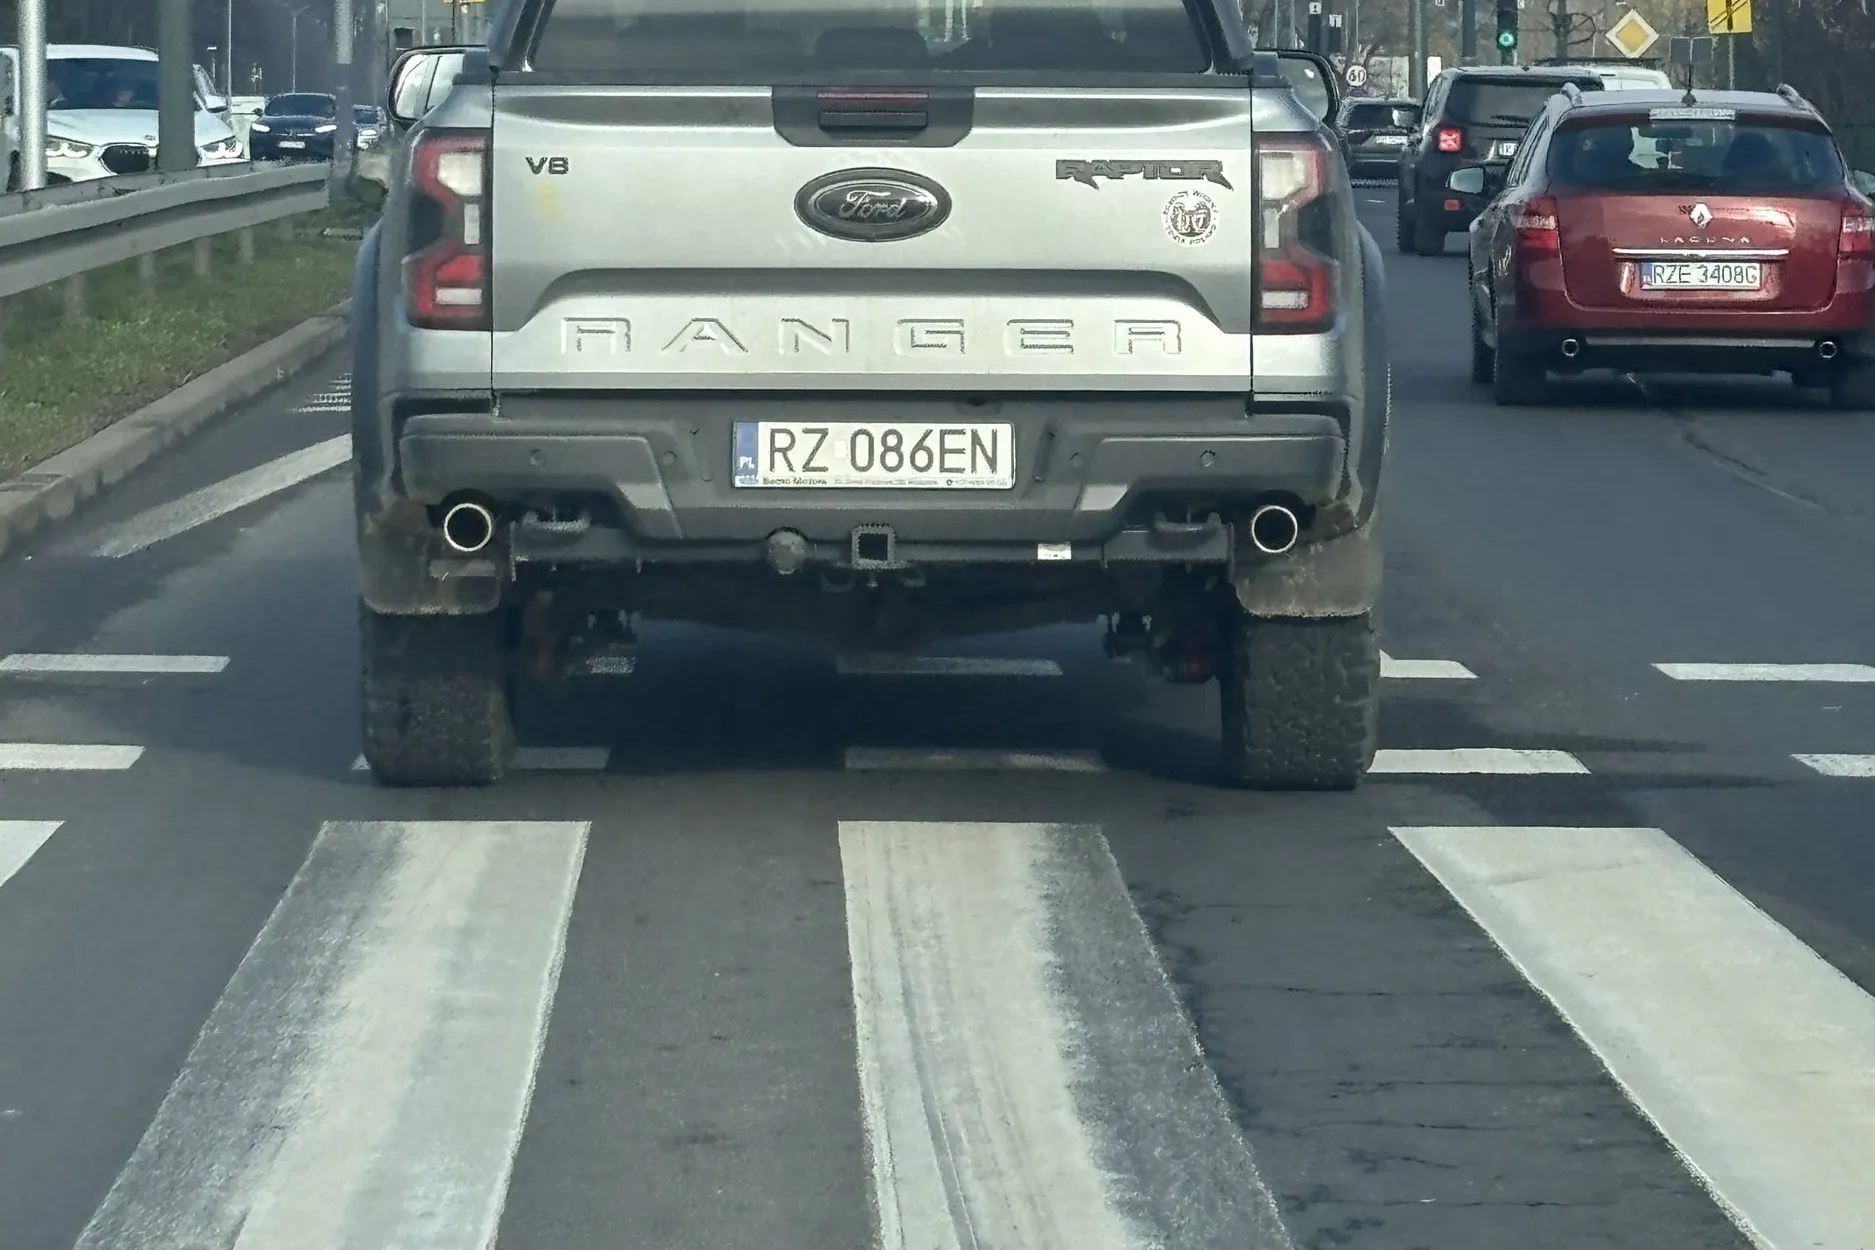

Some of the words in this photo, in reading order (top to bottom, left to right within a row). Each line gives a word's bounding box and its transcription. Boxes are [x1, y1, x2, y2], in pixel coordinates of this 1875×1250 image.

[524, 156, 569, 174] V8
[1055, 159, 1234, 191] RAPTOR
[838, 189, 908, 219] Ford
[1653, 264, 1692, 284] RZE
[560, 316, 1182, 355] RANGER
[769, 428, 829, 473] RZ
[850, 428, 998, 474] 086EN
